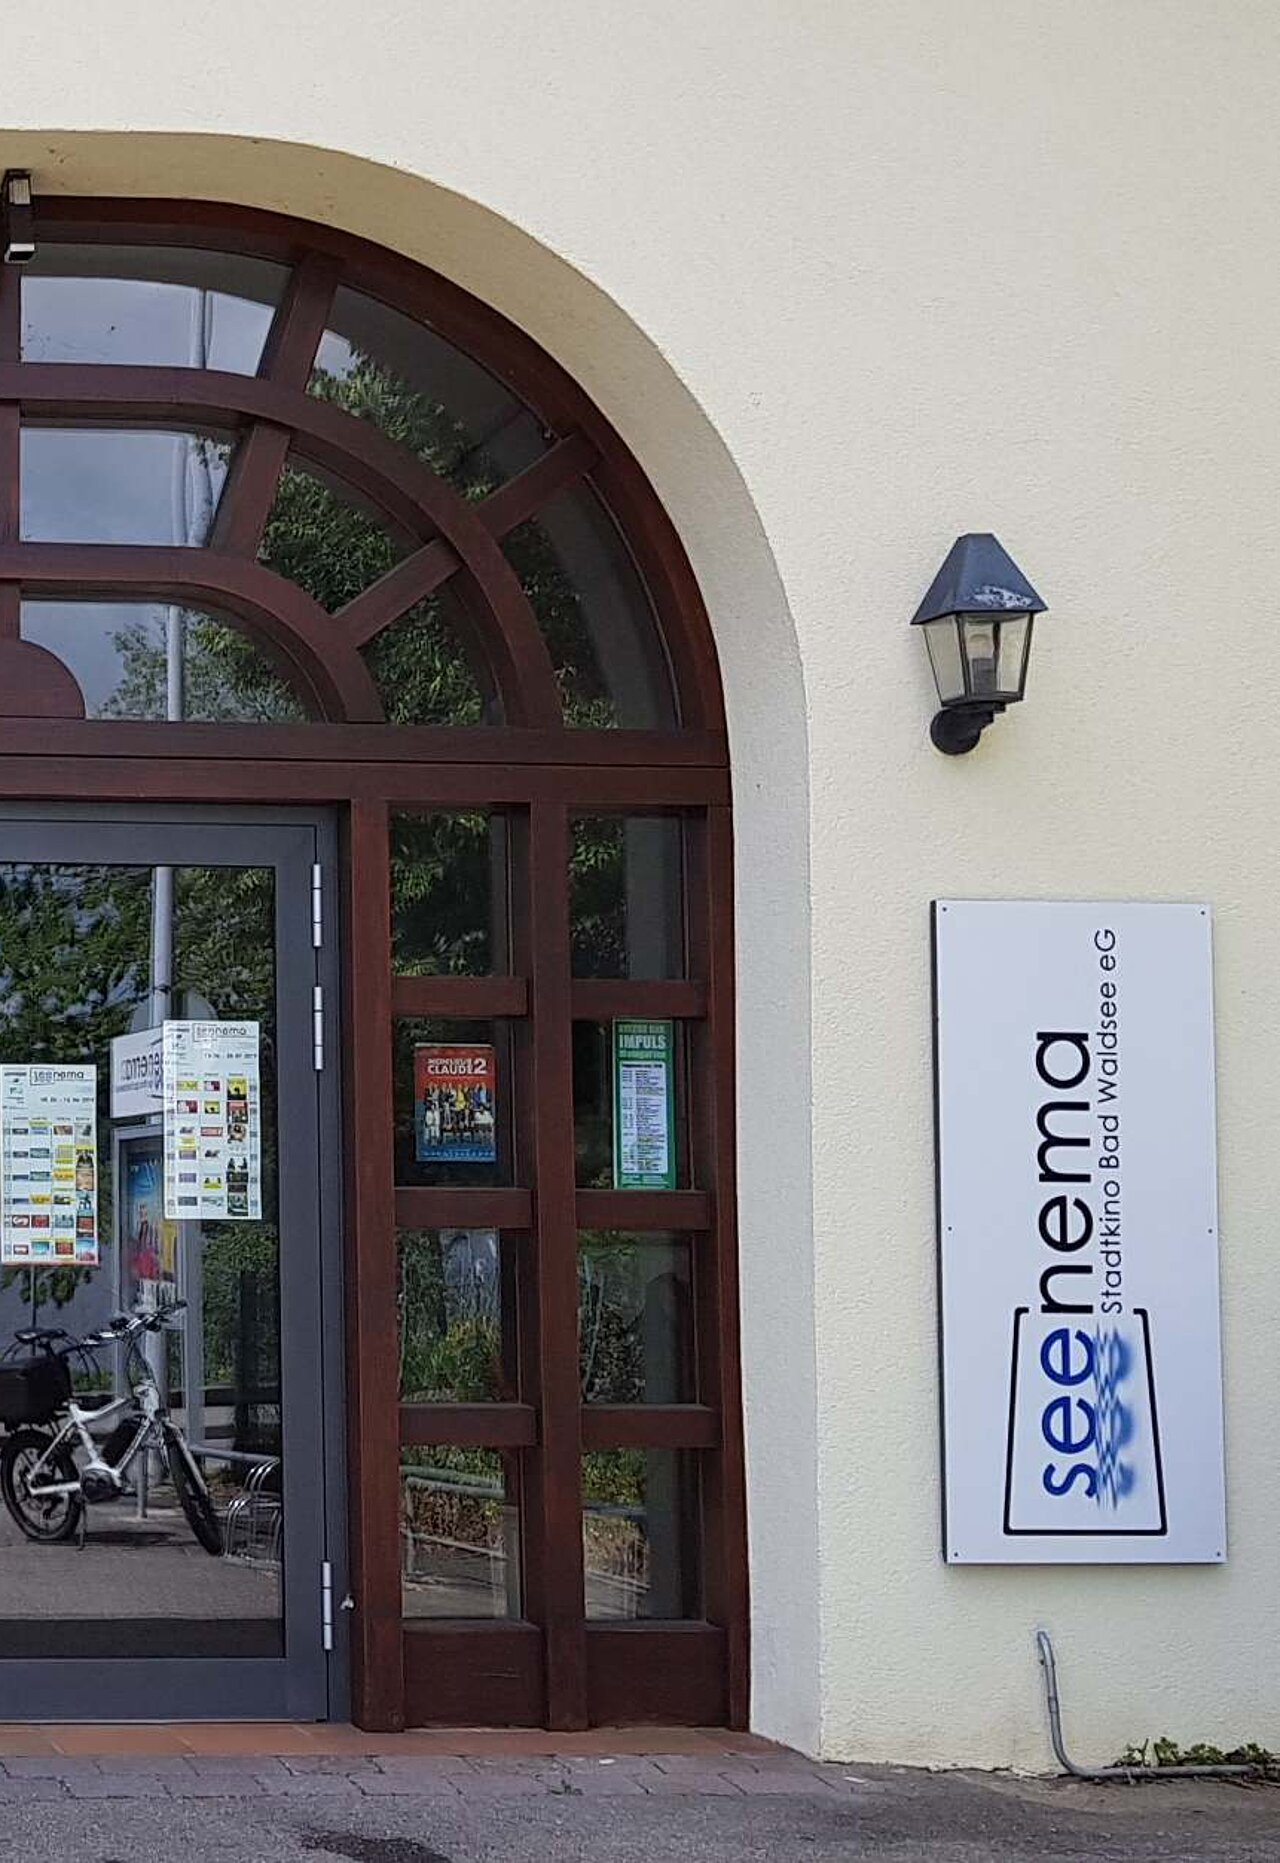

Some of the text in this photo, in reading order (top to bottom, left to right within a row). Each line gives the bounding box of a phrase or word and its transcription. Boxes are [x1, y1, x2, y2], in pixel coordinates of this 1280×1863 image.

[619, 1035, 666, 1050] IMPULS
[1094, 928, 1122, 1314] Stadtkino Bad Waldsee eG
[1034, 1031, 1098, 1498] seenema
